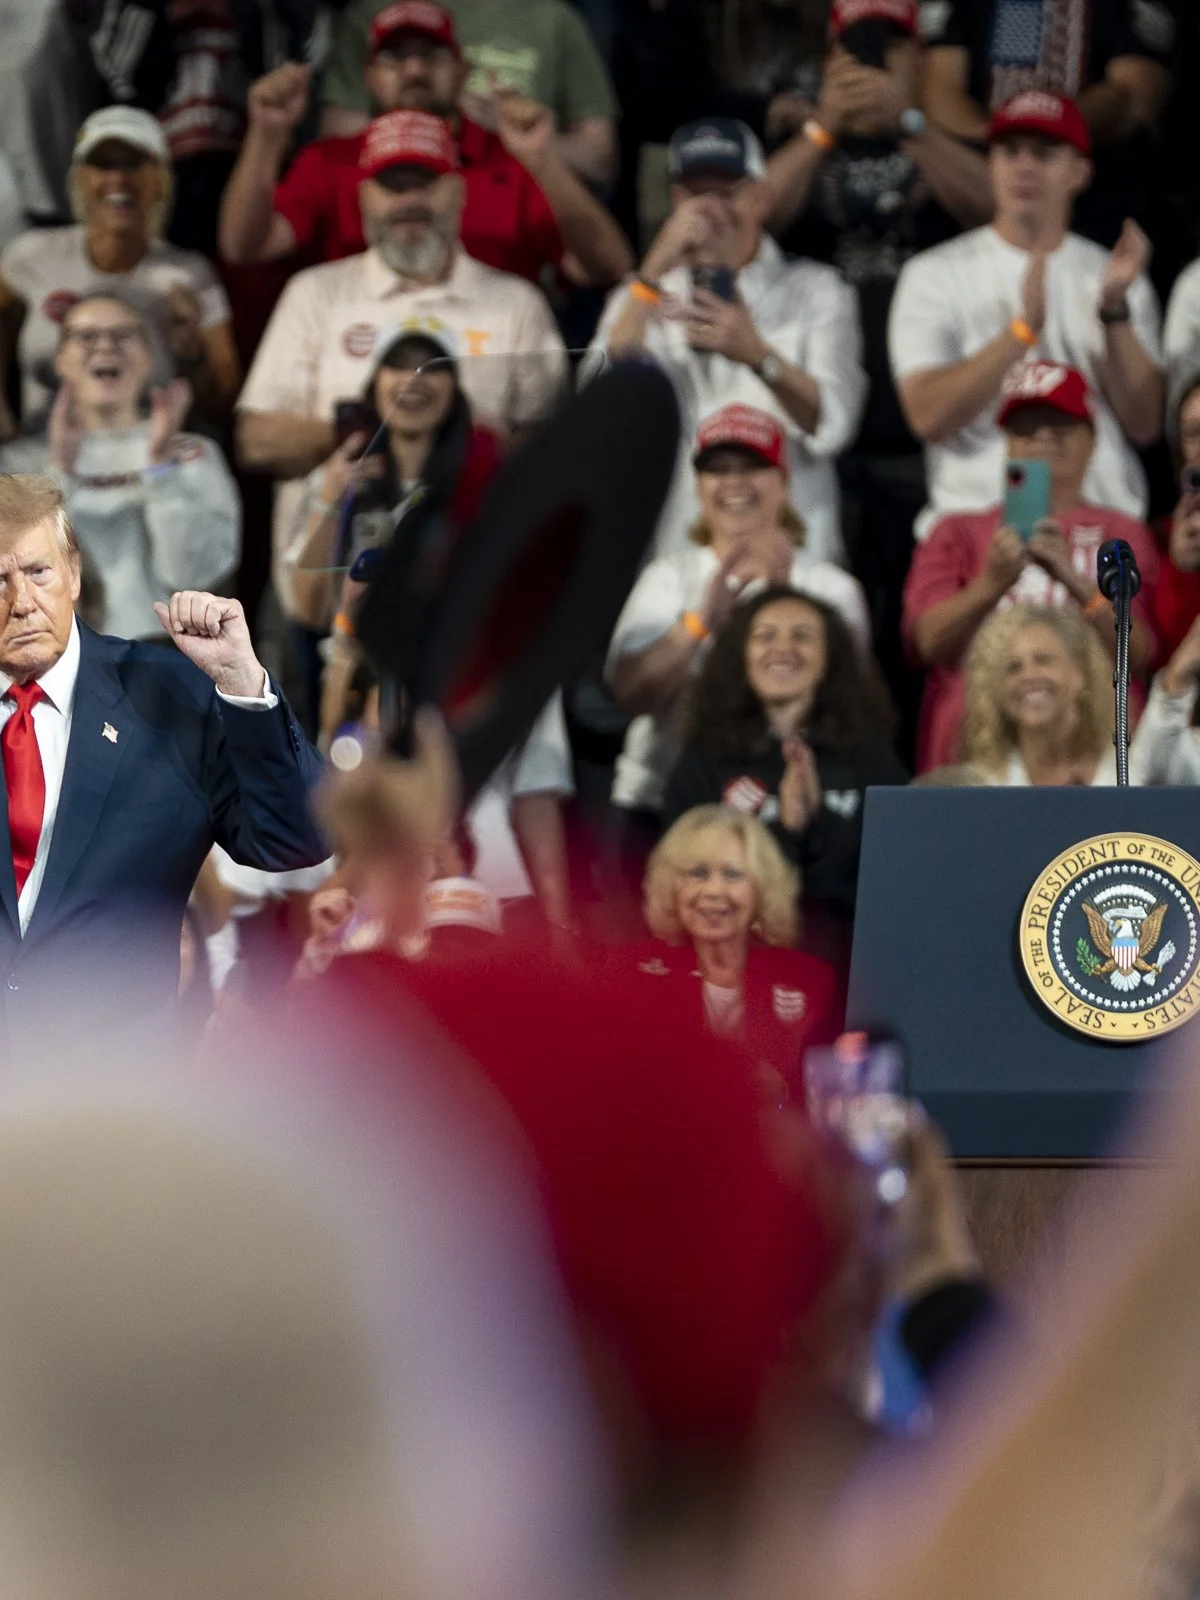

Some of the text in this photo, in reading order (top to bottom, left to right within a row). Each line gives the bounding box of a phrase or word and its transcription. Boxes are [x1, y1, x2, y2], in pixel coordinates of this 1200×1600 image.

[1127, 842, 1146, 855] OF
[1150, 847, 1176, 868] THE
[1028, 840, 1120, 930] PRESIDENT
[1030, 938, 1045, 967] THE
[1038, 970, 1054, 988] OF
[1053, 986, 1105, 1029] SEAL
